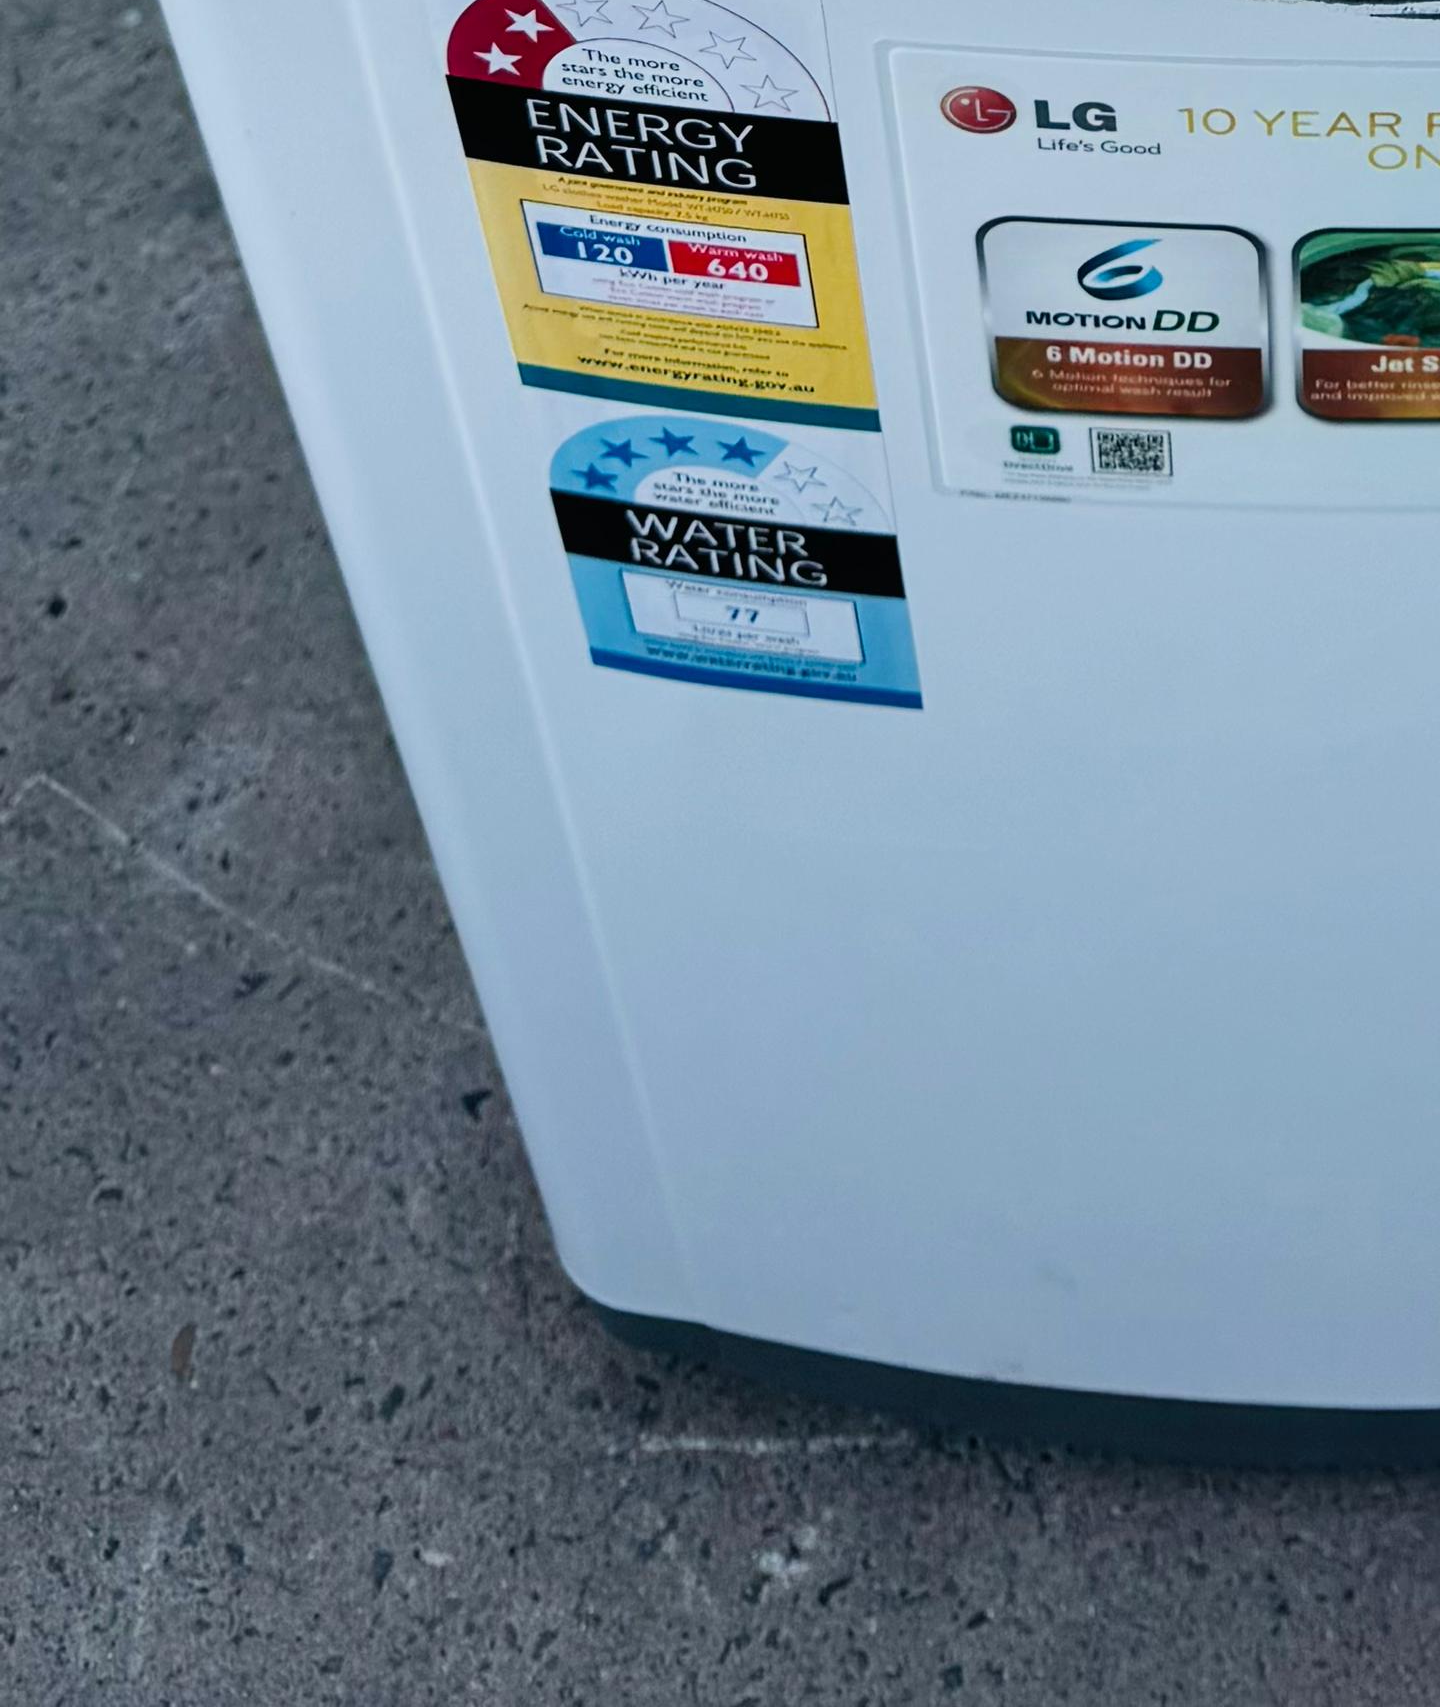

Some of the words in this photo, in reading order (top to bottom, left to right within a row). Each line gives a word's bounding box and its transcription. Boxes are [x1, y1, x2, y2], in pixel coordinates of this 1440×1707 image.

[582, 47, 621, 65] The
[628, 56, 680, 72] more
[561, 62, 607, 77] stars
[613, 67, 645, 82] the
[652, 73, 704, 88] more
[561, 75, 625, 95] energy
[632, 83, 709, 102] efficient
[526, 98, 754, 154] ENERGY
[1033, 99, 1118, 132] LG
[1178, 107, 1238, 136] 10
[1253, 108, 1402, 139] YEAR
[1037, 136, 1095, 154] Life's
[1100, 139, 1162, 156] Good
[536, 134, 758, 189] RATING
[559, 225, 598, 243] Cold
[602, 233, 641, 247] wash
[589, 214, 641, 233] Energy
[646, 223, 748, 243] consumption
[577, 242, 634, 266] 120
[687, 242, 741, 259] Warm
[745, 249, 784, 264] wash
[619, 267, 658, 282] kWh
[663, 274, 687, 286] per
[693, 278, 725, 291] year
[707, 258, 768, 283] 640
[1025, 309, 1146, 331] MOTION
[1152, 309, 1220, 333] DD
[1046, 345, 1062, 363] 6
[1069, 345, 1165, 368] Motion
[1173, 350, 1213, 370] DD
[1370, 354, 1415, 374] Jet
[712, 480, 759, 492] more
[733, 492, 780, 506] more
[624, 508, 809, 557] WATER
[629, 536, 829, 588] RATING
[724, 603, 761, 624] 77
